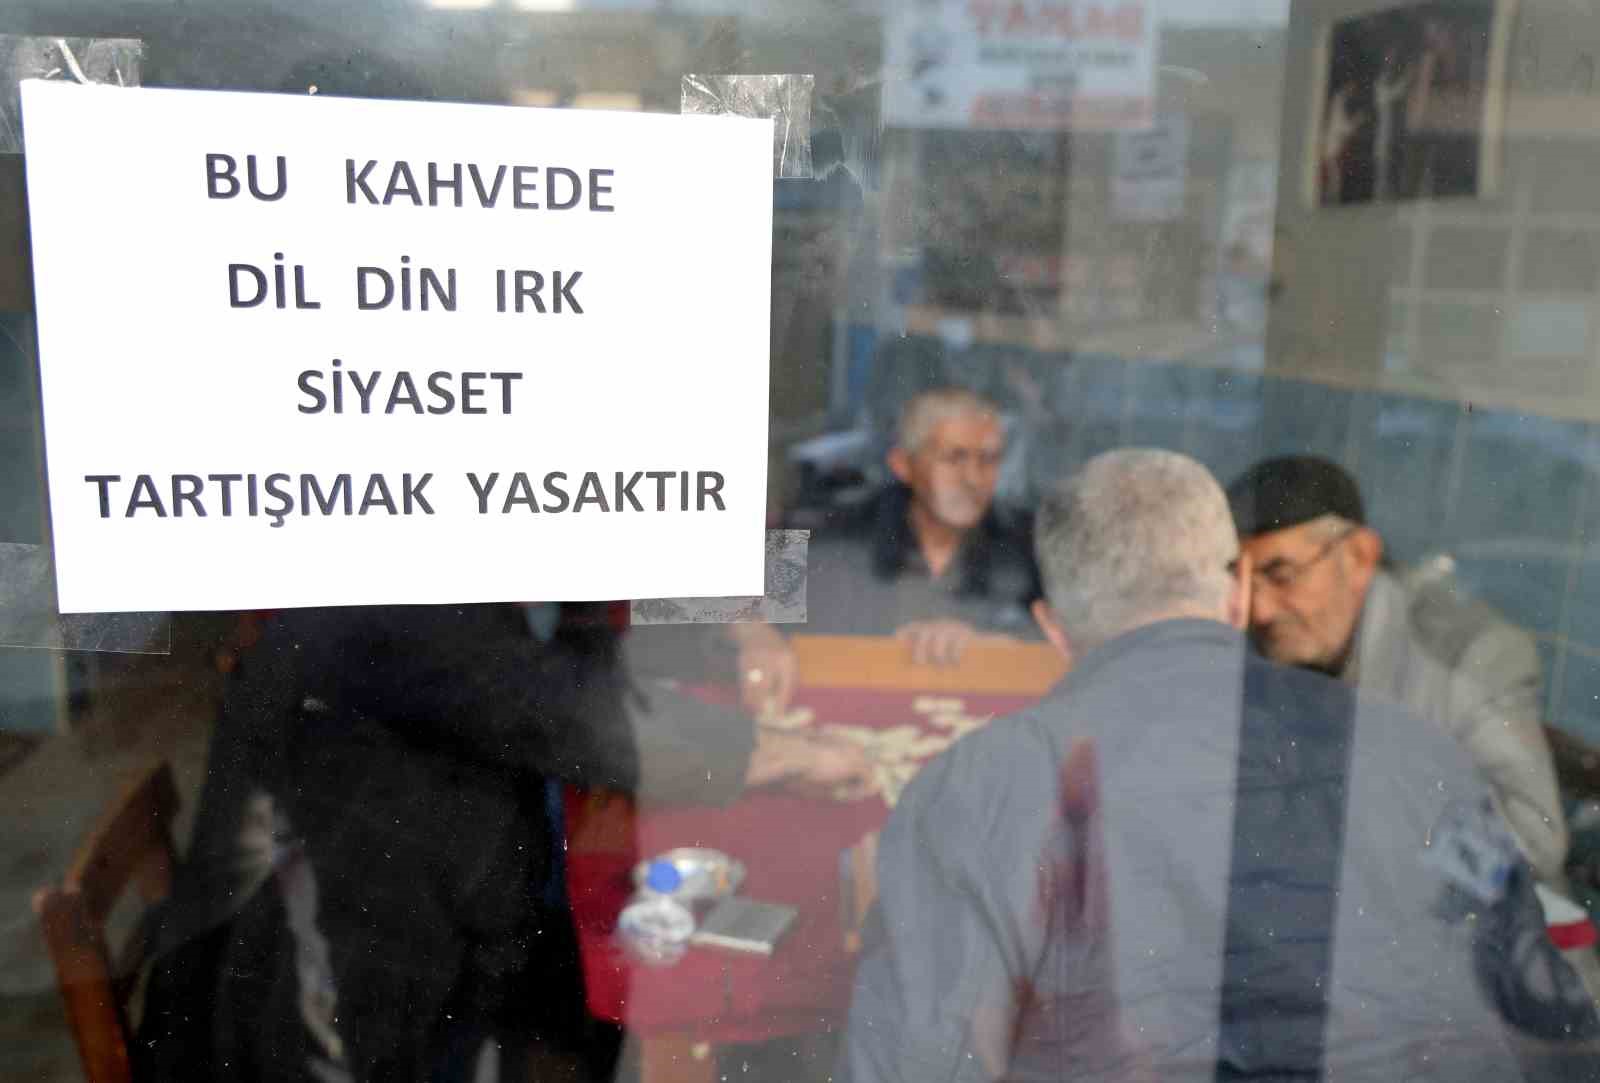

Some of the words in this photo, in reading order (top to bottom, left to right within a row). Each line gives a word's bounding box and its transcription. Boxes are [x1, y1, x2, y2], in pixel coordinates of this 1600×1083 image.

[206, 153, 287, 203] BU
[346, 159, 615, 213] KAHVEDE
[228, 252, 321, 309] DİL
[357, 255, 457, 313] DİN
[496, 269, 585, 314] IRK
[297, 358, 523, 415] SİYASET
[84, 472, 435, 528] TARTIŞMAK
[466, 471, 726, 515] YASAKTIR
